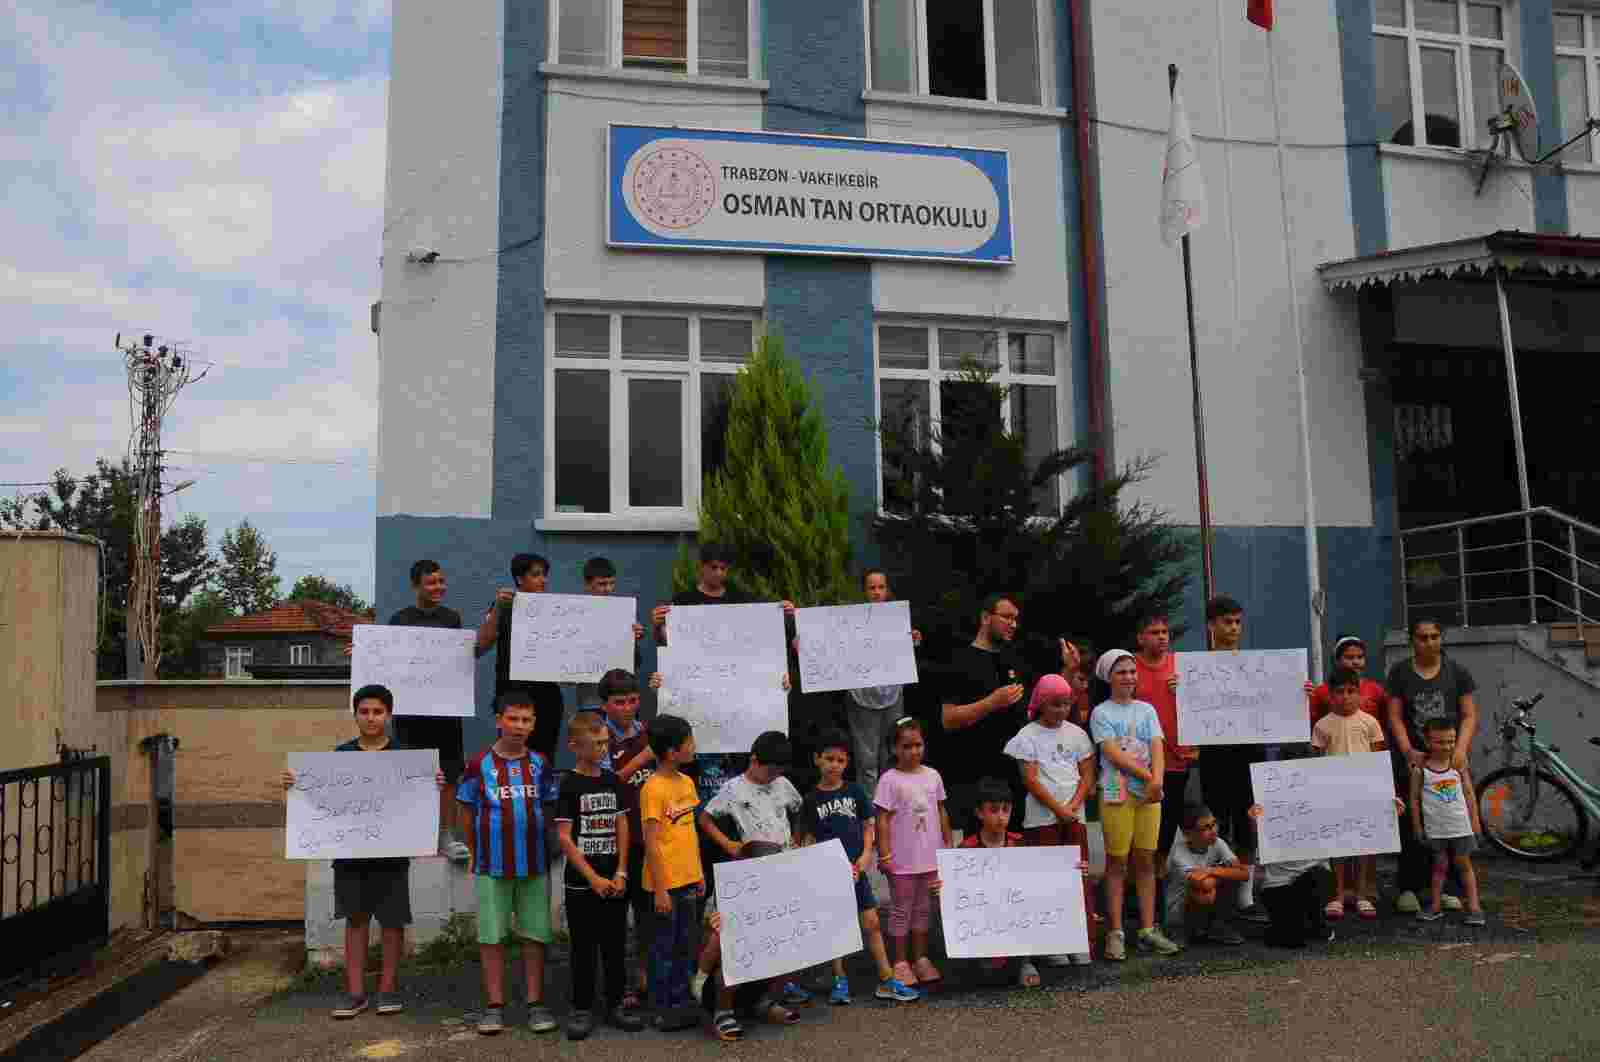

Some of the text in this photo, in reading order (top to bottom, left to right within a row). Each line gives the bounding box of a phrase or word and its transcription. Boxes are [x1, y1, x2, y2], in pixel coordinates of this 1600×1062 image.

[722, 165, 788, 182] TRABZON
[800, 168, 879, 189] VAKFIKEBİR
[723, 193, 986, 228] OSMAN TAN ORTAOKULU
